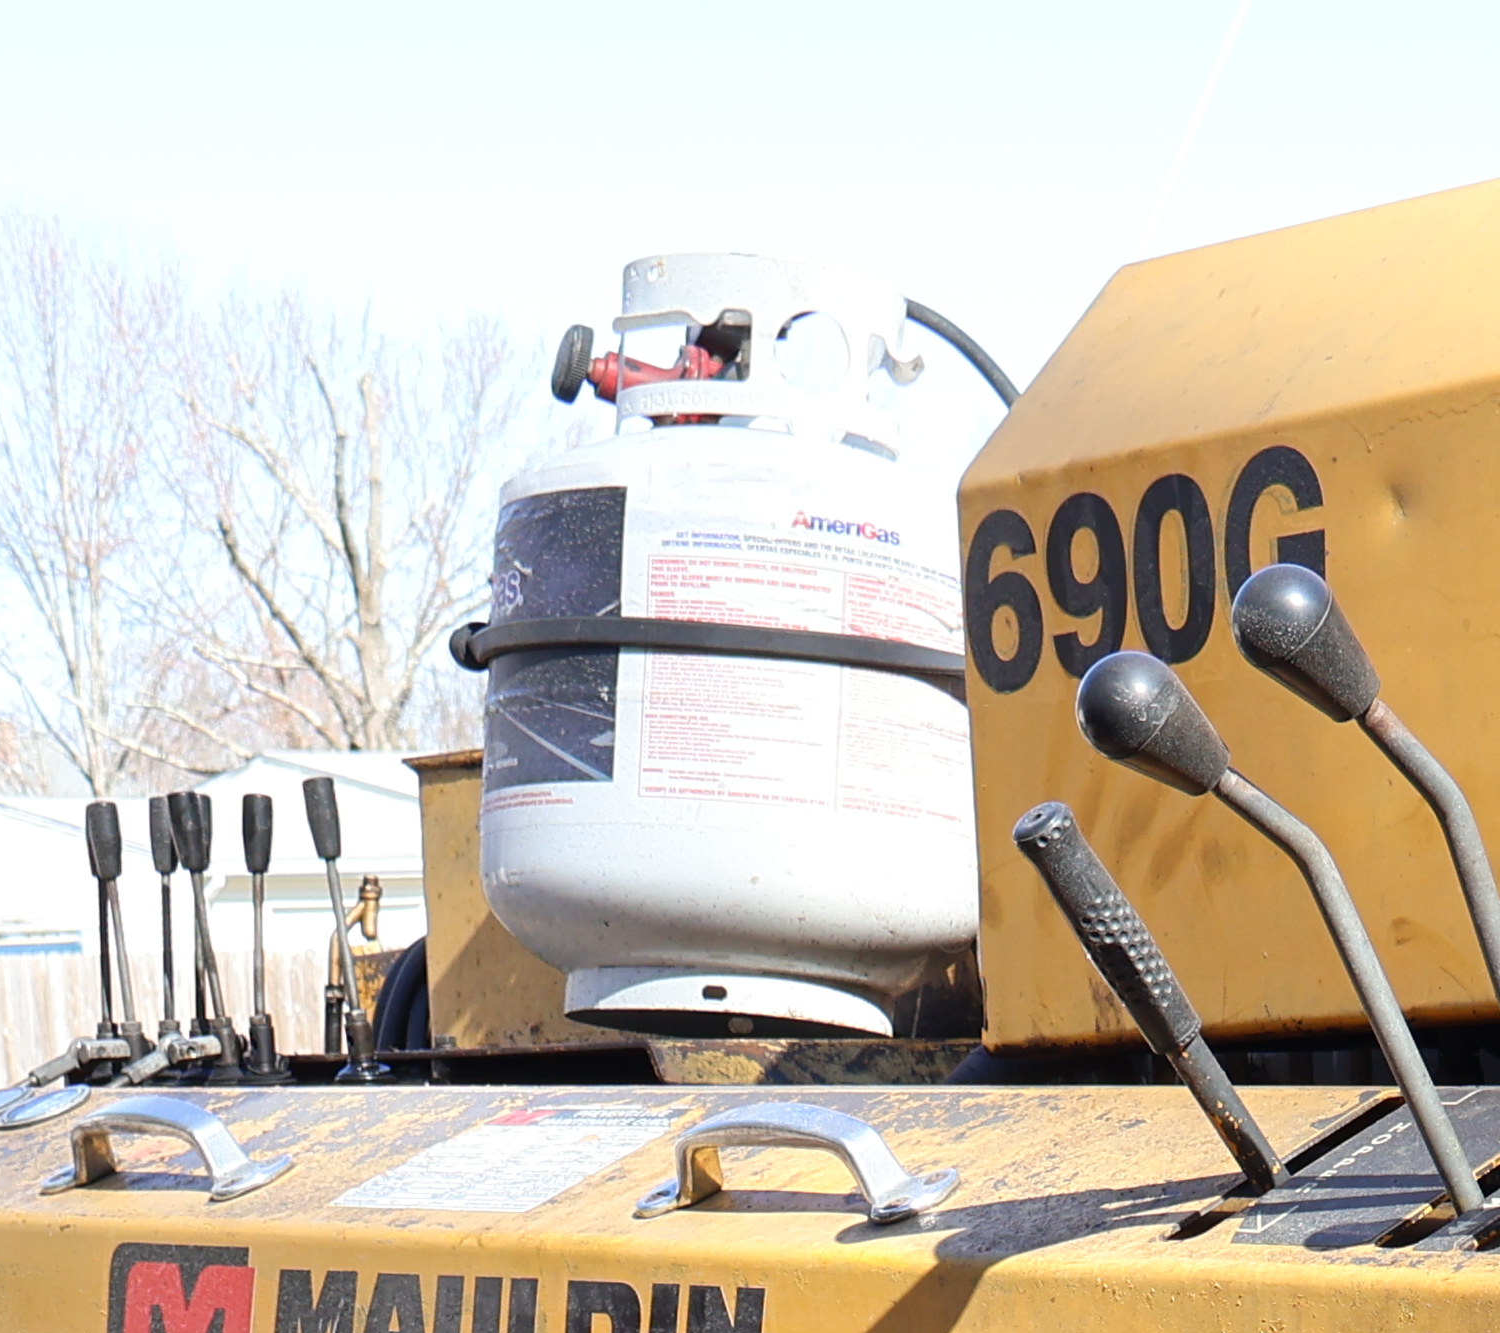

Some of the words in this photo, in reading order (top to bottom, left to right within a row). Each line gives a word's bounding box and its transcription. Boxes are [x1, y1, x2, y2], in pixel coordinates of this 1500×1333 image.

[791, 510, 900, 546] AmeriGas
[965, 445, 1326, 694] 690G
[1295, 1122, 1412, 1193] HOPPER
